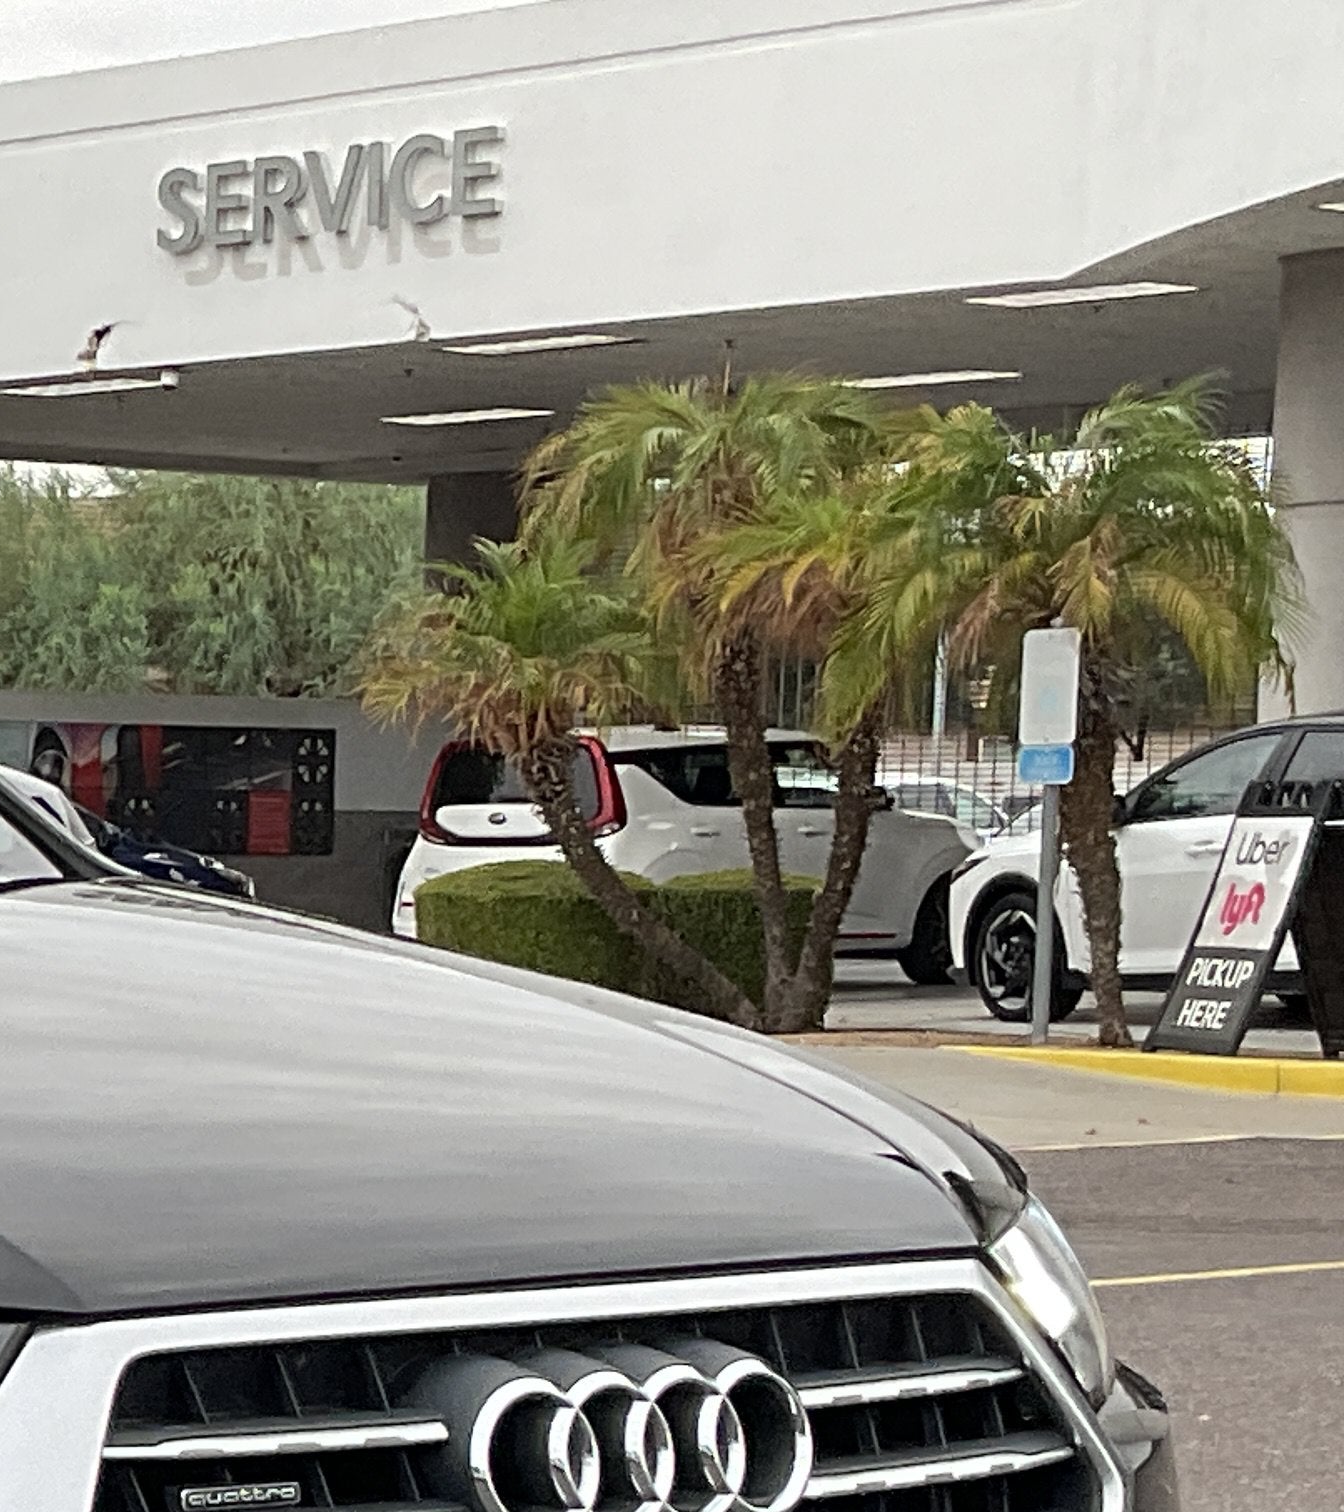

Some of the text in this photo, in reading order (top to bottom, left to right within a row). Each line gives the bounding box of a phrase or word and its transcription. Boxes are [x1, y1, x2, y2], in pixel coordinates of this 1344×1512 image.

[156, 126, 504, 256] SERVICE
[1235, 831, 1291, 865] Uber
[1220, 881, 1266, 936] lyft
[1185, 957, 1255, 989] PICKUP
[1176, 998, 1232, 1030] HERE
[188, 1486, 296, 1506] quattro
